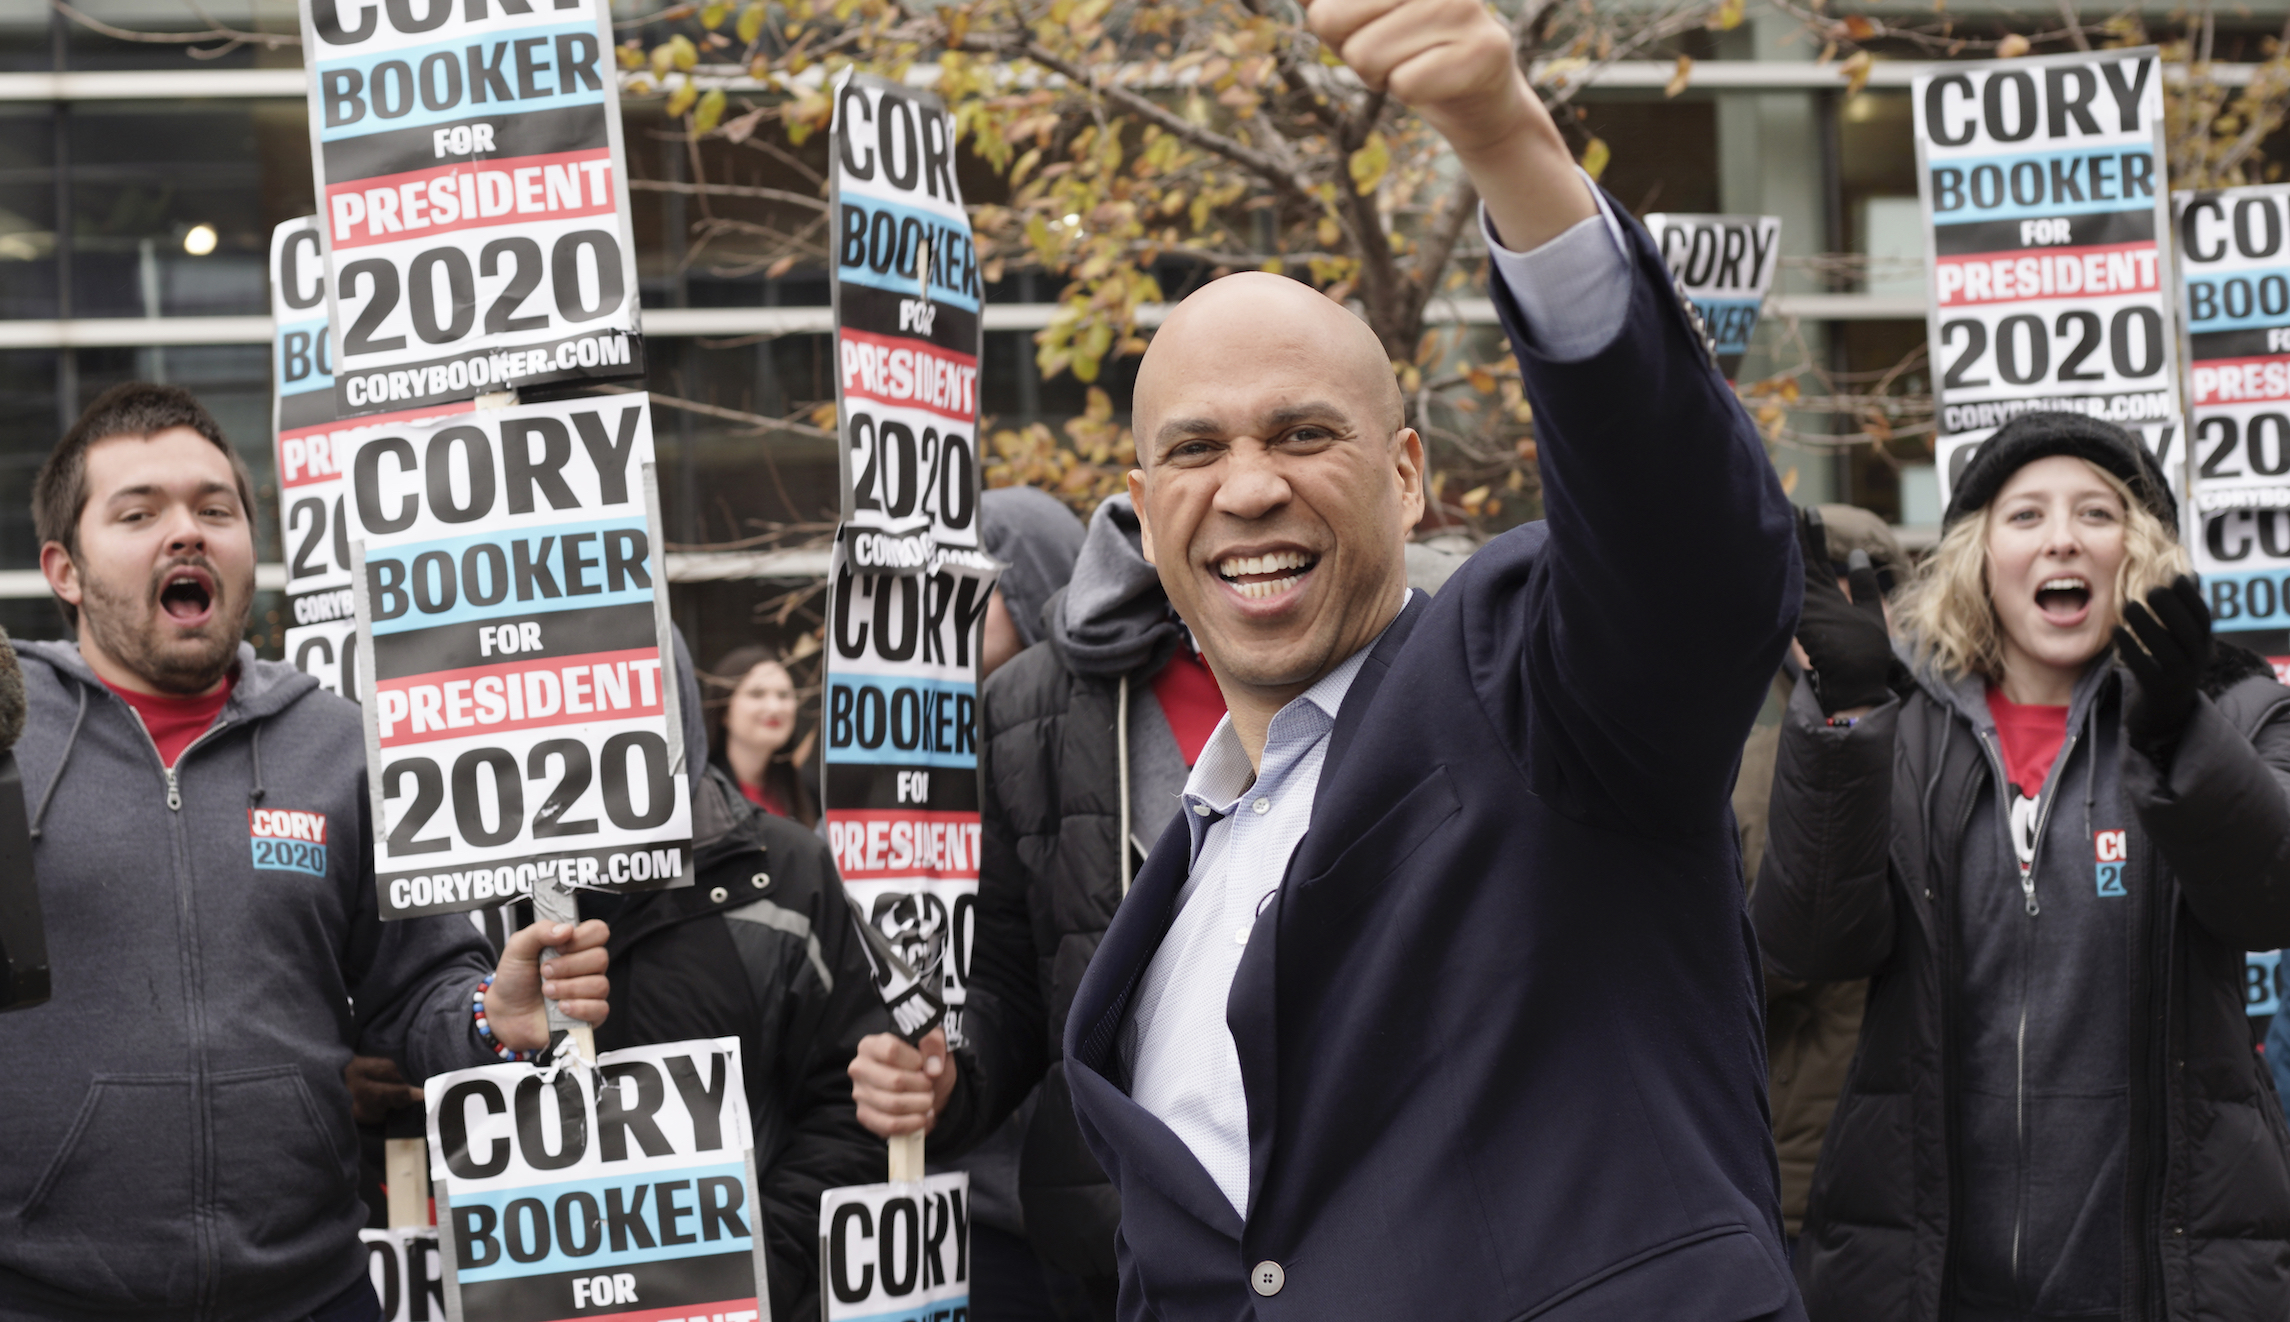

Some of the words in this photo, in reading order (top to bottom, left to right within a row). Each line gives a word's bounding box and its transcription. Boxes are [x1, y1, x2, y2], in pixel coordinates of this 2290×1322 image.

[321, 32, 603, 129] BOOKER
[1925, 58, 2152, 147] CORY
[434, 123, 496, 158] FOR
[838, 84, 957, 206] COR
[331, 158, 613, 241] PRESIDENT
[1932, 150, 2154, 213] BOOKER
[840, 203, 980, 299] BOOKER
[1662, 226, 1775, 289] CORY
[2020, 218, 2071, 247] FOR
[2182, 196, 2290, 263] CO
[338, 229, 625, 357] 2020
[1936, 249, 2159, 302] PRESIDENT
[2188, 275, 2290, 321] BOO
[346, 334, 631, 407] CORYBOOKER.COM
[841, 338, 977, 415] PRESIDENT
[1941, 305, 2164, 390] 2020
[353, 406, 642, 536] CORY
[851, 411, 974, 531] 2020
[2197, 412, 2290, 479] 20
[366, 528, 652, 624] BOOKER
[834, 560, 997, 668] CORY
[479, 621, 543, 657] FOR
[376, 658, 662, 738] PRESIDENT
[830, 684, 977, 756] BOOKER
[252, 809, 326, 843] CORY
[382, 731, 676, 858] 2020
[256, 840, 324, 872] 2020
[438, 1051, 730, 1180] CORY
[452, 1174, 752, 1269] BOOKER
[831, 1185, 969, 1304] CORY
[572, 1273, 639, 1309] FOR
